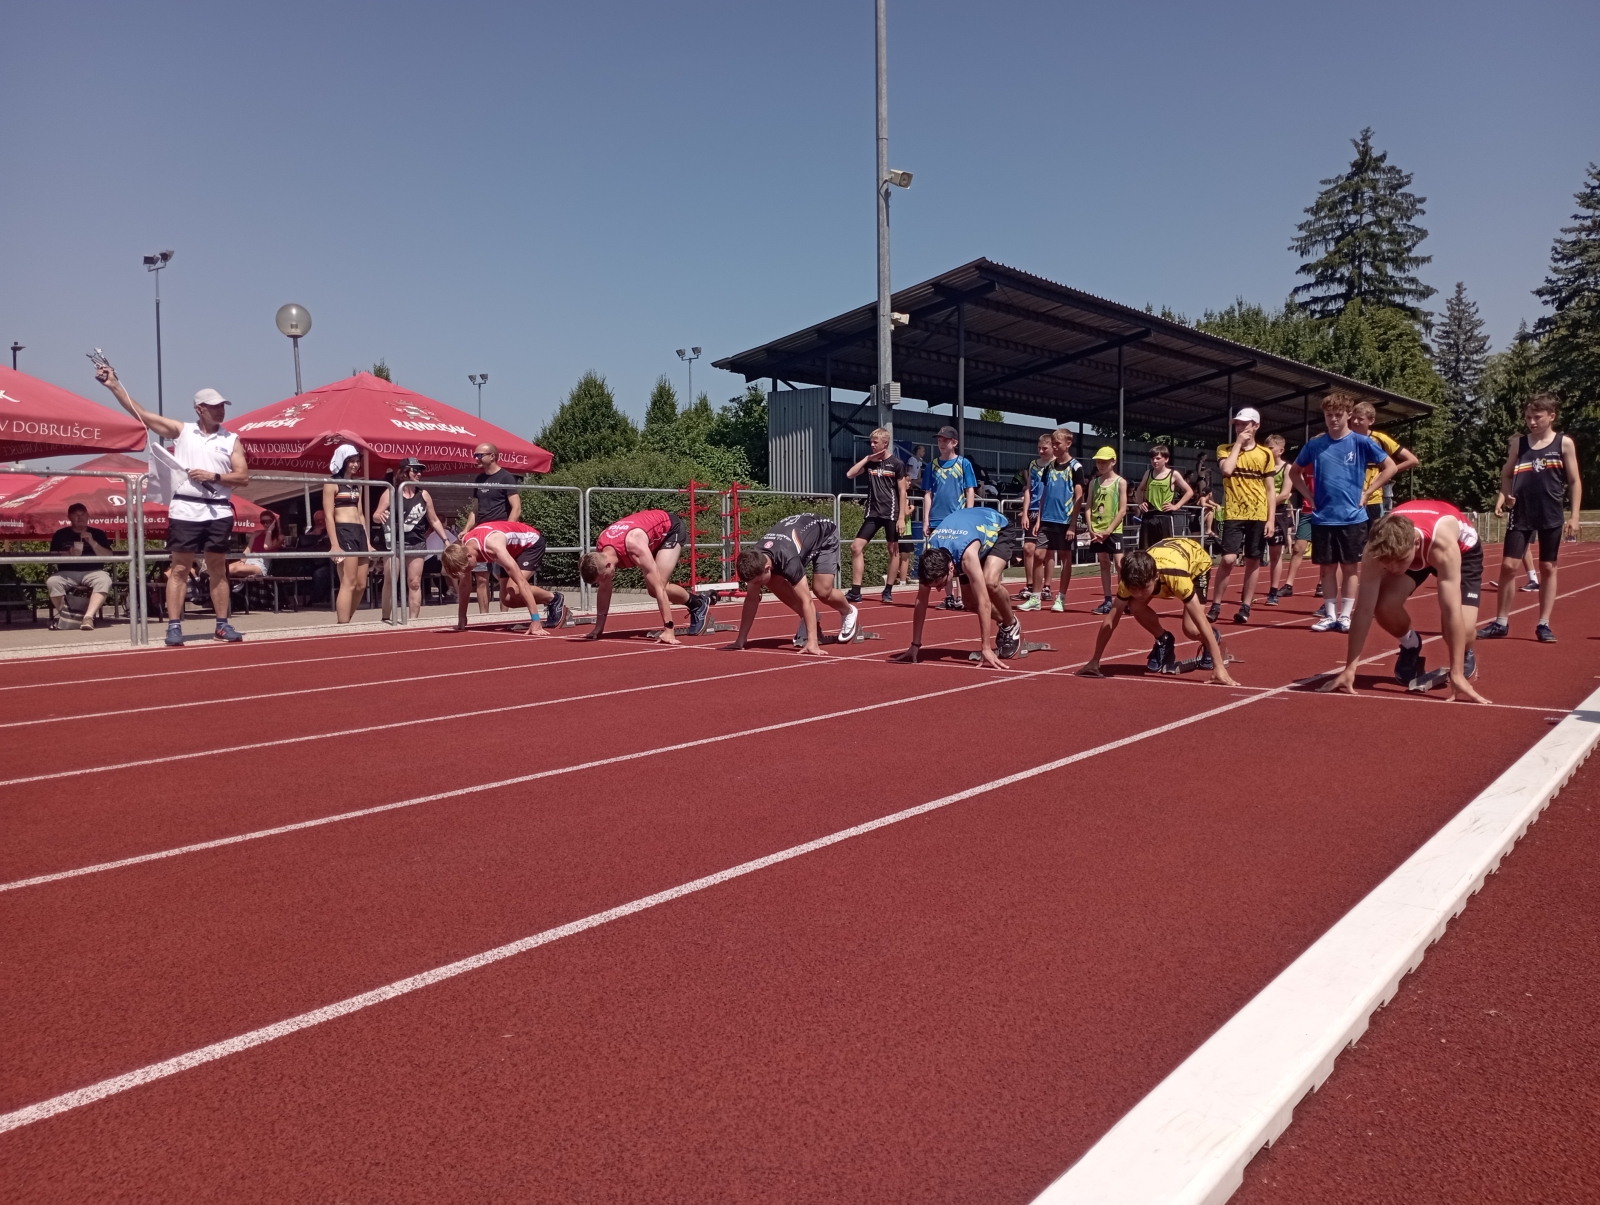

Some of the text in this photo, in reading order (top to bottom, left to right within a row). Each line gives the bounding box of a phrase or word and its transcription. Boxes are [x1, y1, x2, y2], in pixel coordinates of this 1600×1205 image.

[13, 420, 101, 440] DOBRUŠCE
[267, 440, 308, 453] DOBRUŠC
[424, 445, 468, 458] PIVOVAR
